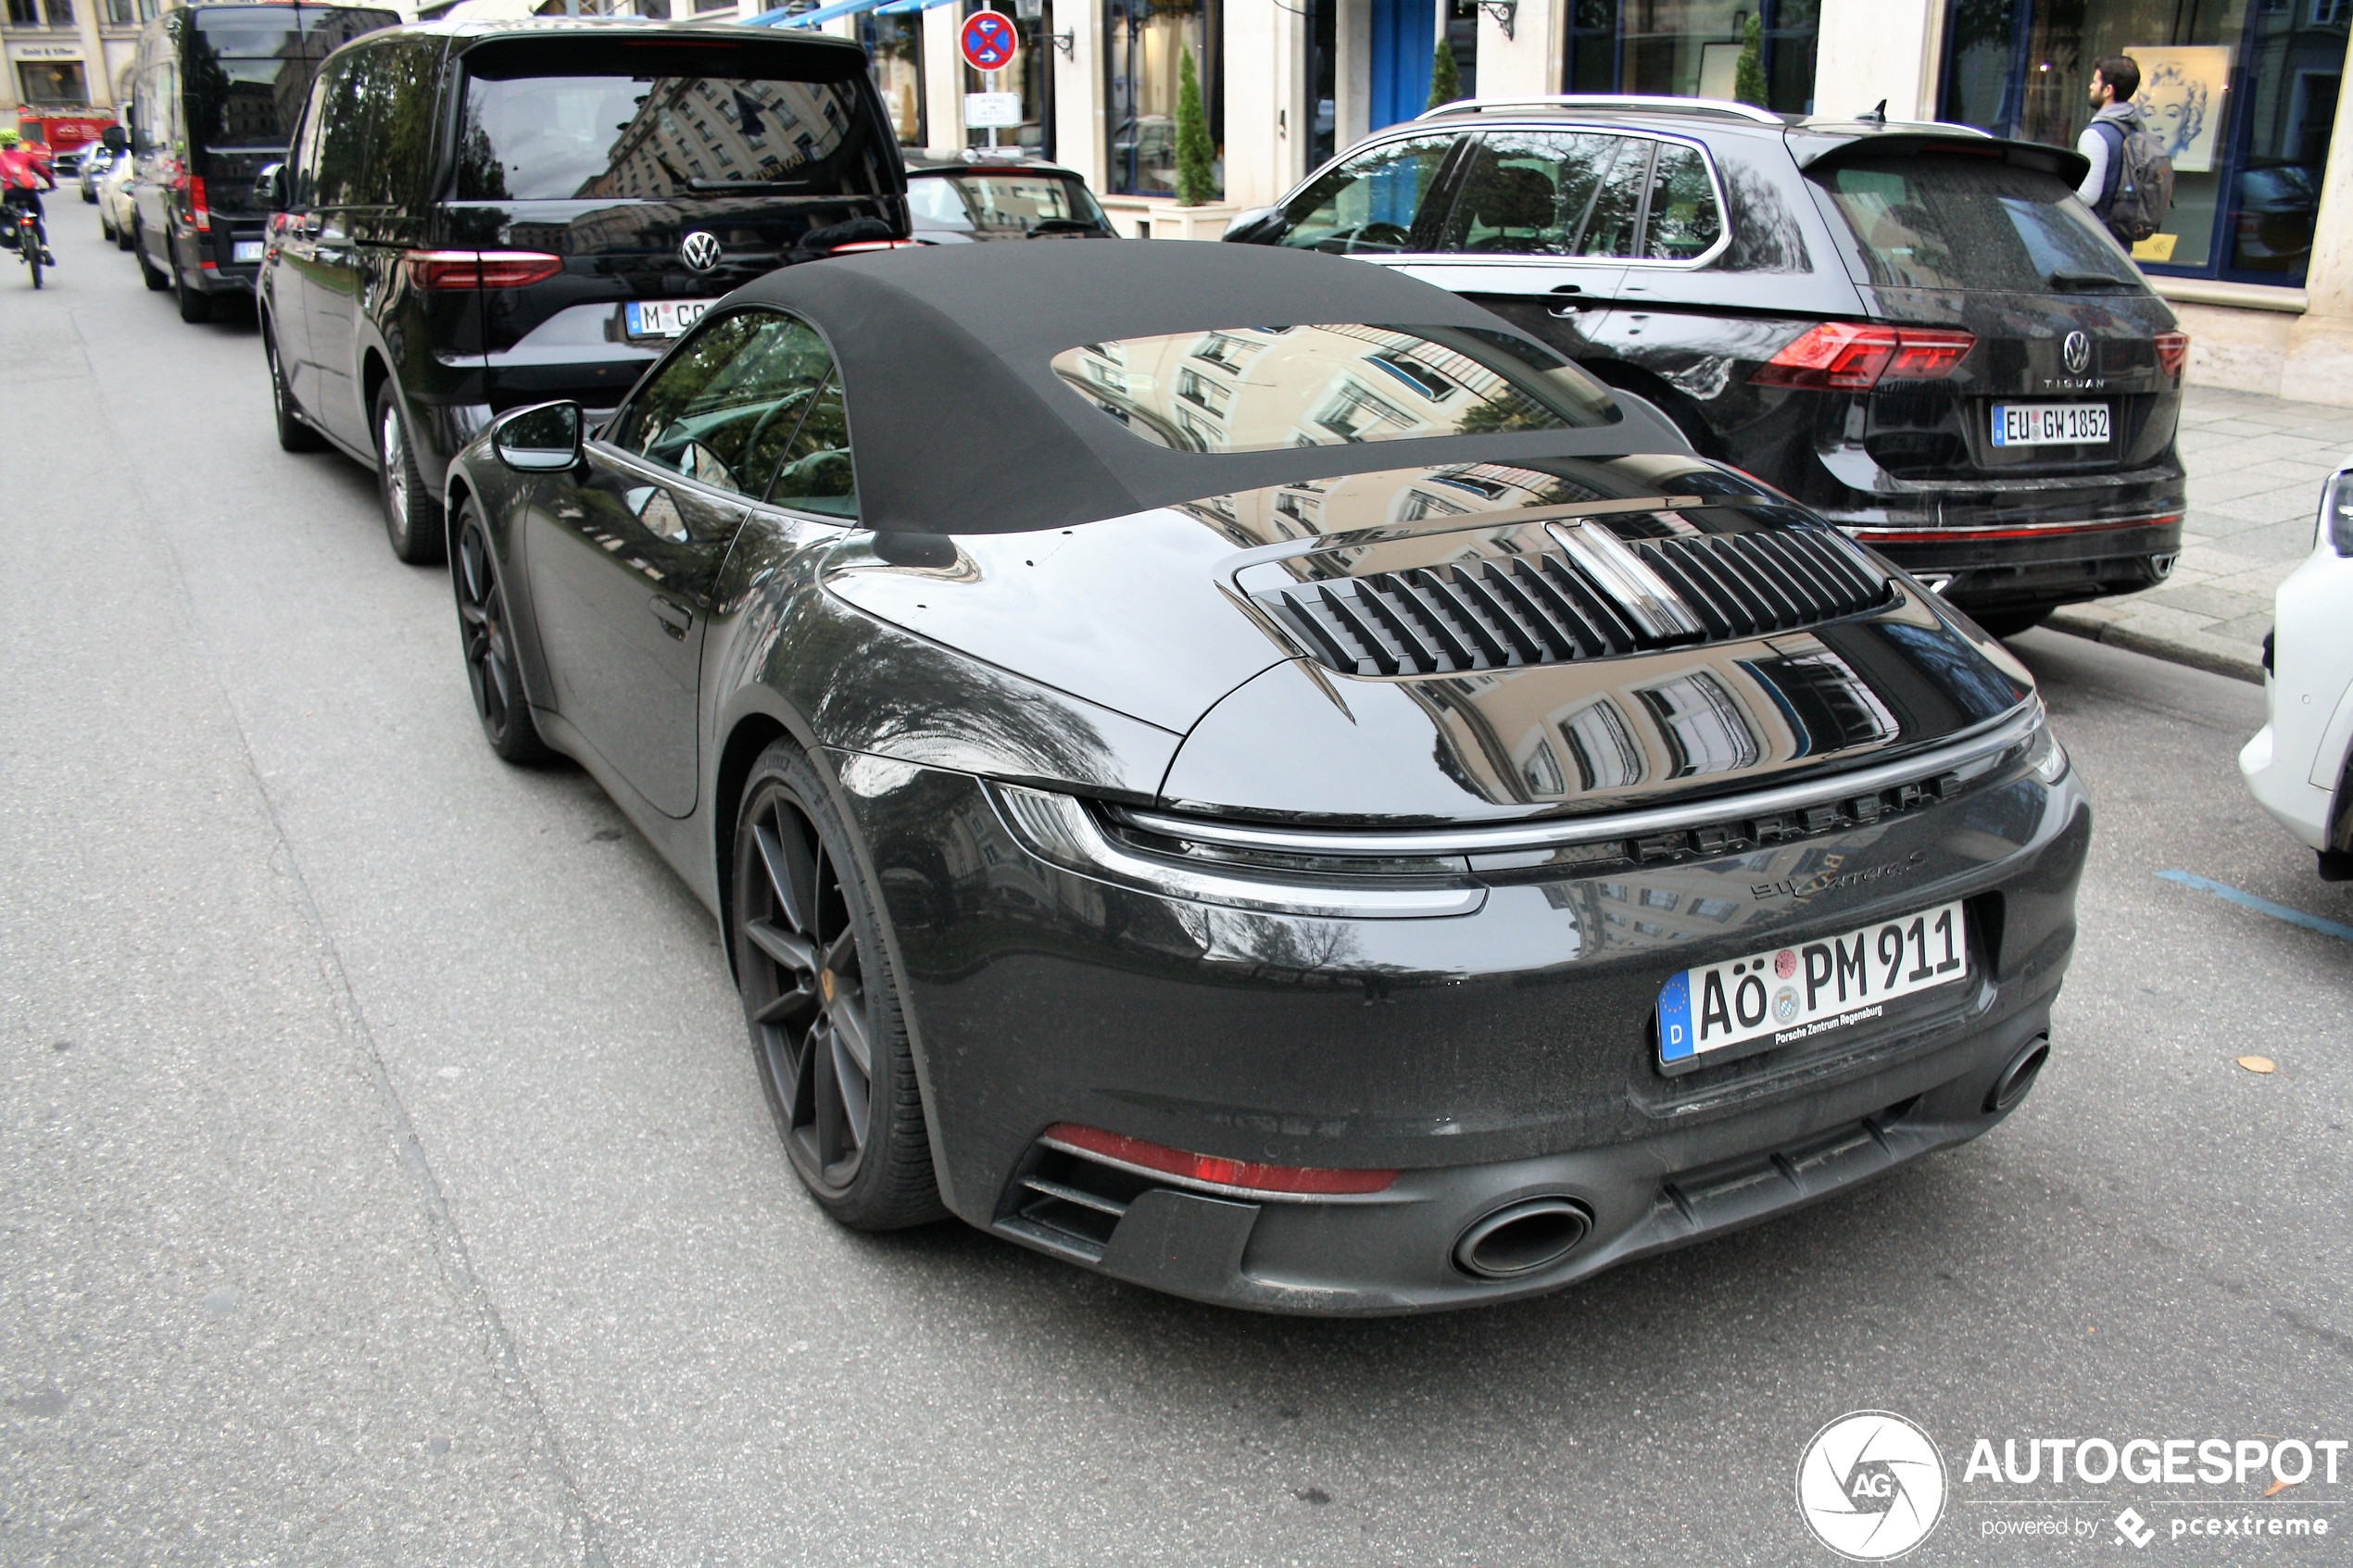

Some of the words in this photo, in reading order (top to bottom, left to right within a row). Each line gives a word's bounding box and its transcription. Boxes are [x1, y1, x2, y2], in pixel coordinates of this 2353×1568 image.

[682, 232, 722, 270] VW
[644, 306, 661, 329] M
[2064, 331, 2091, 374] VW
[2044, 379, 2105, 388] TIGUAN
[2007, 411, 2030, 440] EU
[2044, 410, 2065, 439] GW
[2070, 409, 2108, 438] 1852
[1629, 771, 1963, 865] PORSCHE
[1750, 879, 1795, 900] 911
[1794, 861, 1902, 898] Carrera
[1905, 849, 1928, 872] S
[1670, 1024, 1683, 1045] D
[1700, 958, 1767, 1040] AÖ
[1801, 932, 1867, 1010] PM
[1877, 909, 1960, 989] 911
[1775, 1027, 1806, 1045] Porsche
[1807, 1018, 1839, 1035] Zentrum
[1840, 1005, 1882, 1025] Regensburg
